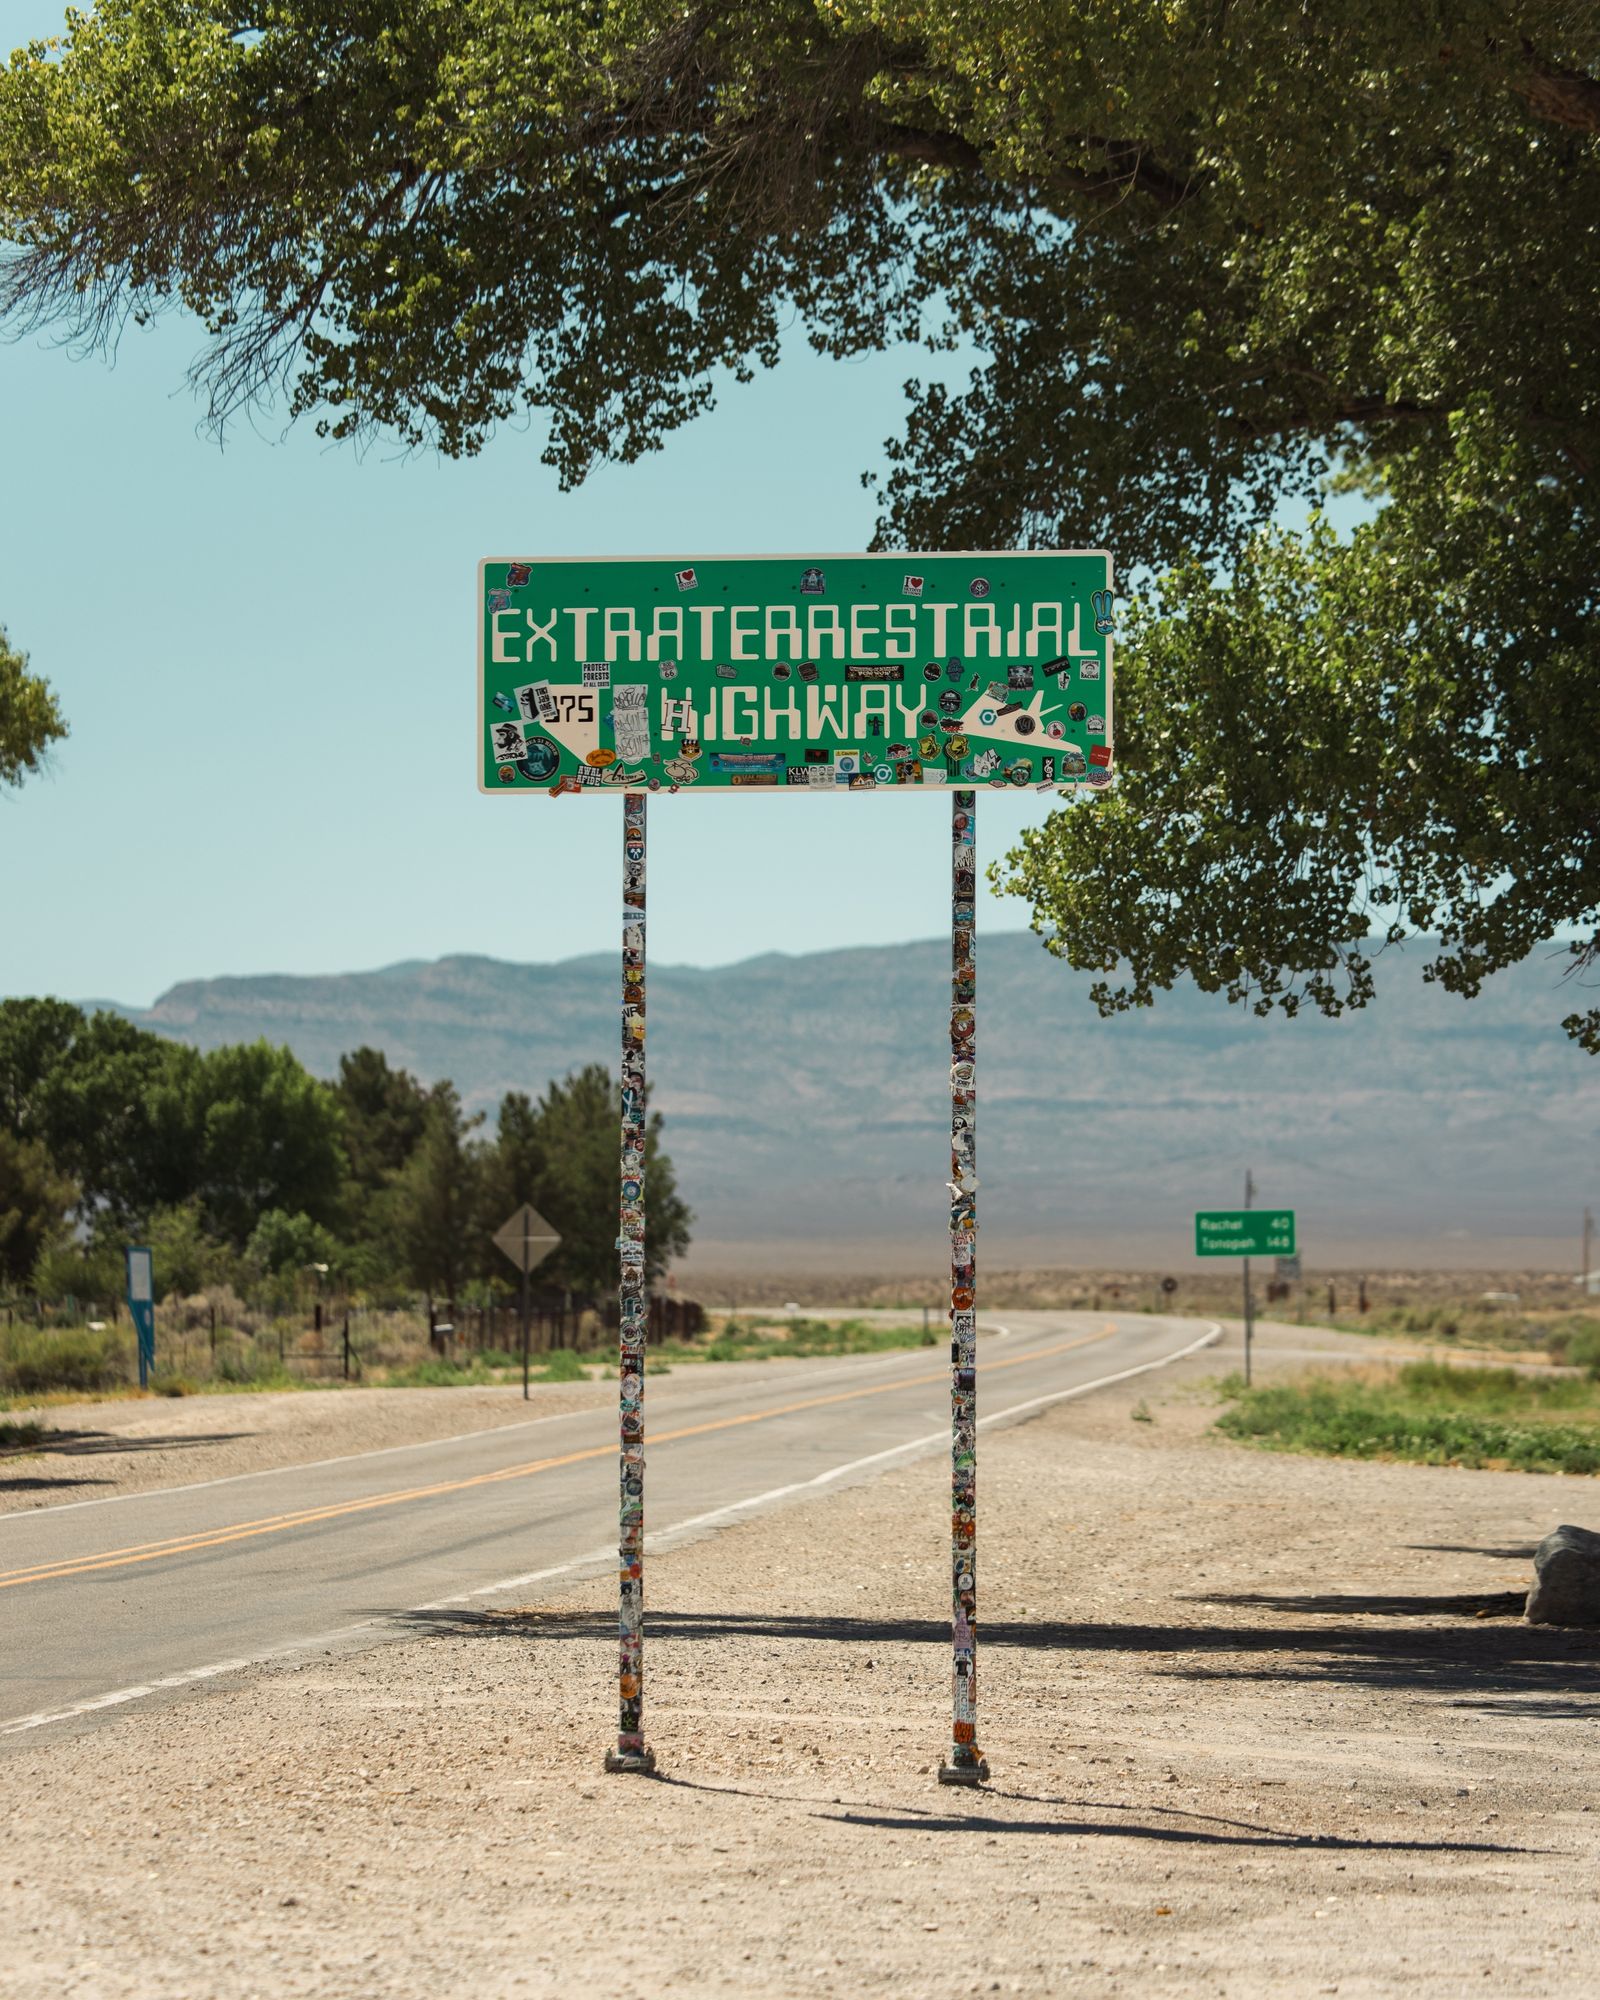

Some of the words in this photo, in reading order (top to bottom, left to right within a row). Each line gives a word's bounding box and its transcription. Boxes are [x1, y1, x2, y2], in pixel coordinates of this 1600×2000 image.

[491, 602, 1099, 663] EXTRATERRESTRIAL
[583, 663, 609, 672] PROTECT
[664, 669, 675, 678] 66
[583, 672, 610, 681] FORESTS
[661, 684, 926, 740] HIGHWAY
[661, 699, 692, 734] H
[1200, 1218, 1242, 1230] Rachel
[1202, 1236, 1256, 1251] Tonopah
